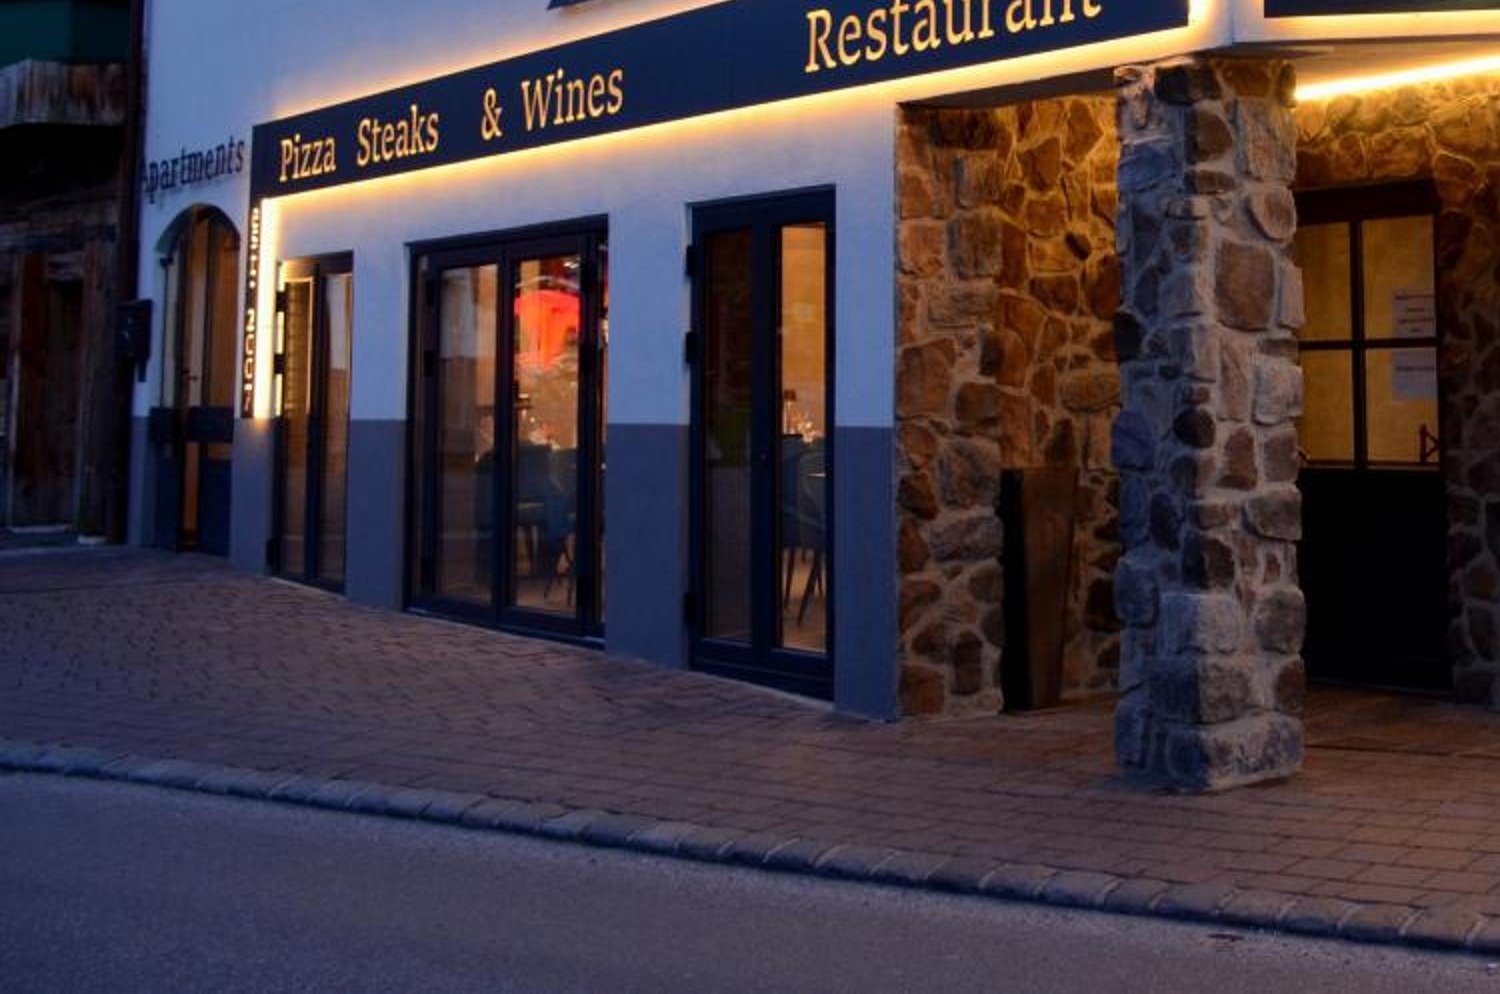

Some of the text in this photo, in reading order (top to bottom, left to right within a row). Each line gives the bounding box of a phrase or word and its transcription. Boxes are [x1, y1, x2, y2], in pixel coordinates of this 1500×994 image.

[279, 133, 337, 183] Pizza
[356, 103, 440, 167] Steaks
[480, 86, 503, 142] &
[520, 67, 625, 132] Wines
